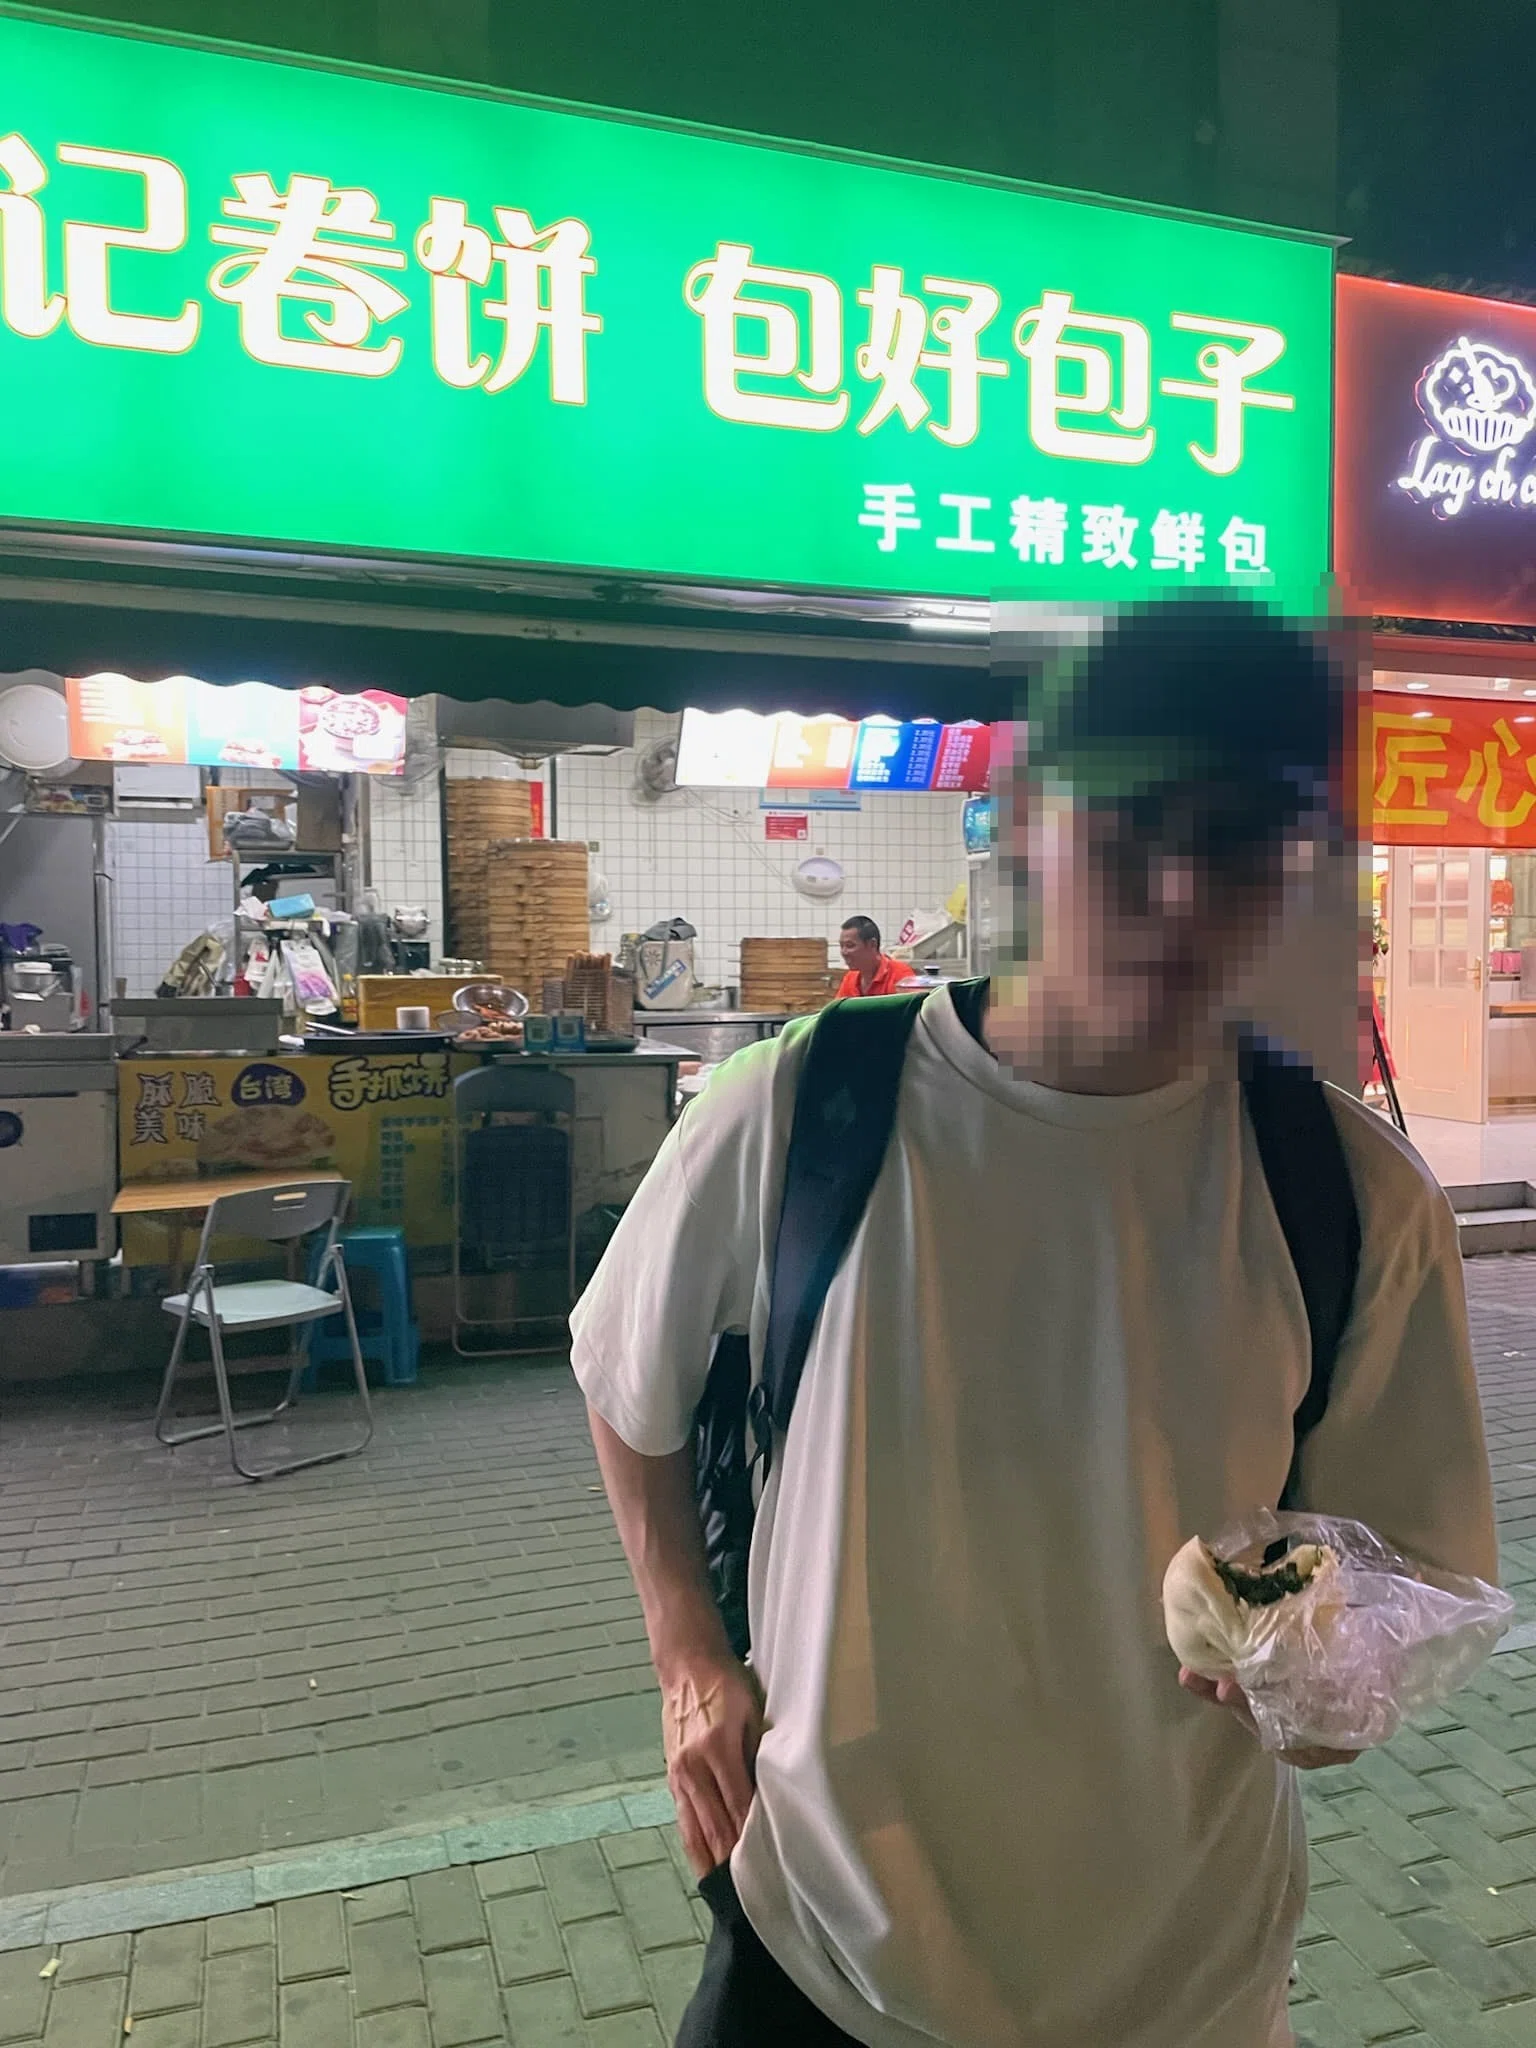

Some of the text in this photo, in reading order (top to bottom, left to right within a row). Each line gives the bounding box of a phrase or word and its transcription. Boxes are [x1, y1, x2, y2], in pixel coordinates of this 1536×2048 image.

[0, 132, 1295, 476] 记卷饼 包好包子
[857, 482, 1271, 573] 手工精致鲜包
[1373, 711, 1536, 828] 匠心
[130, 1105, 207, 1146] 美味
[240, 1074, 293, 1100] 台湾
